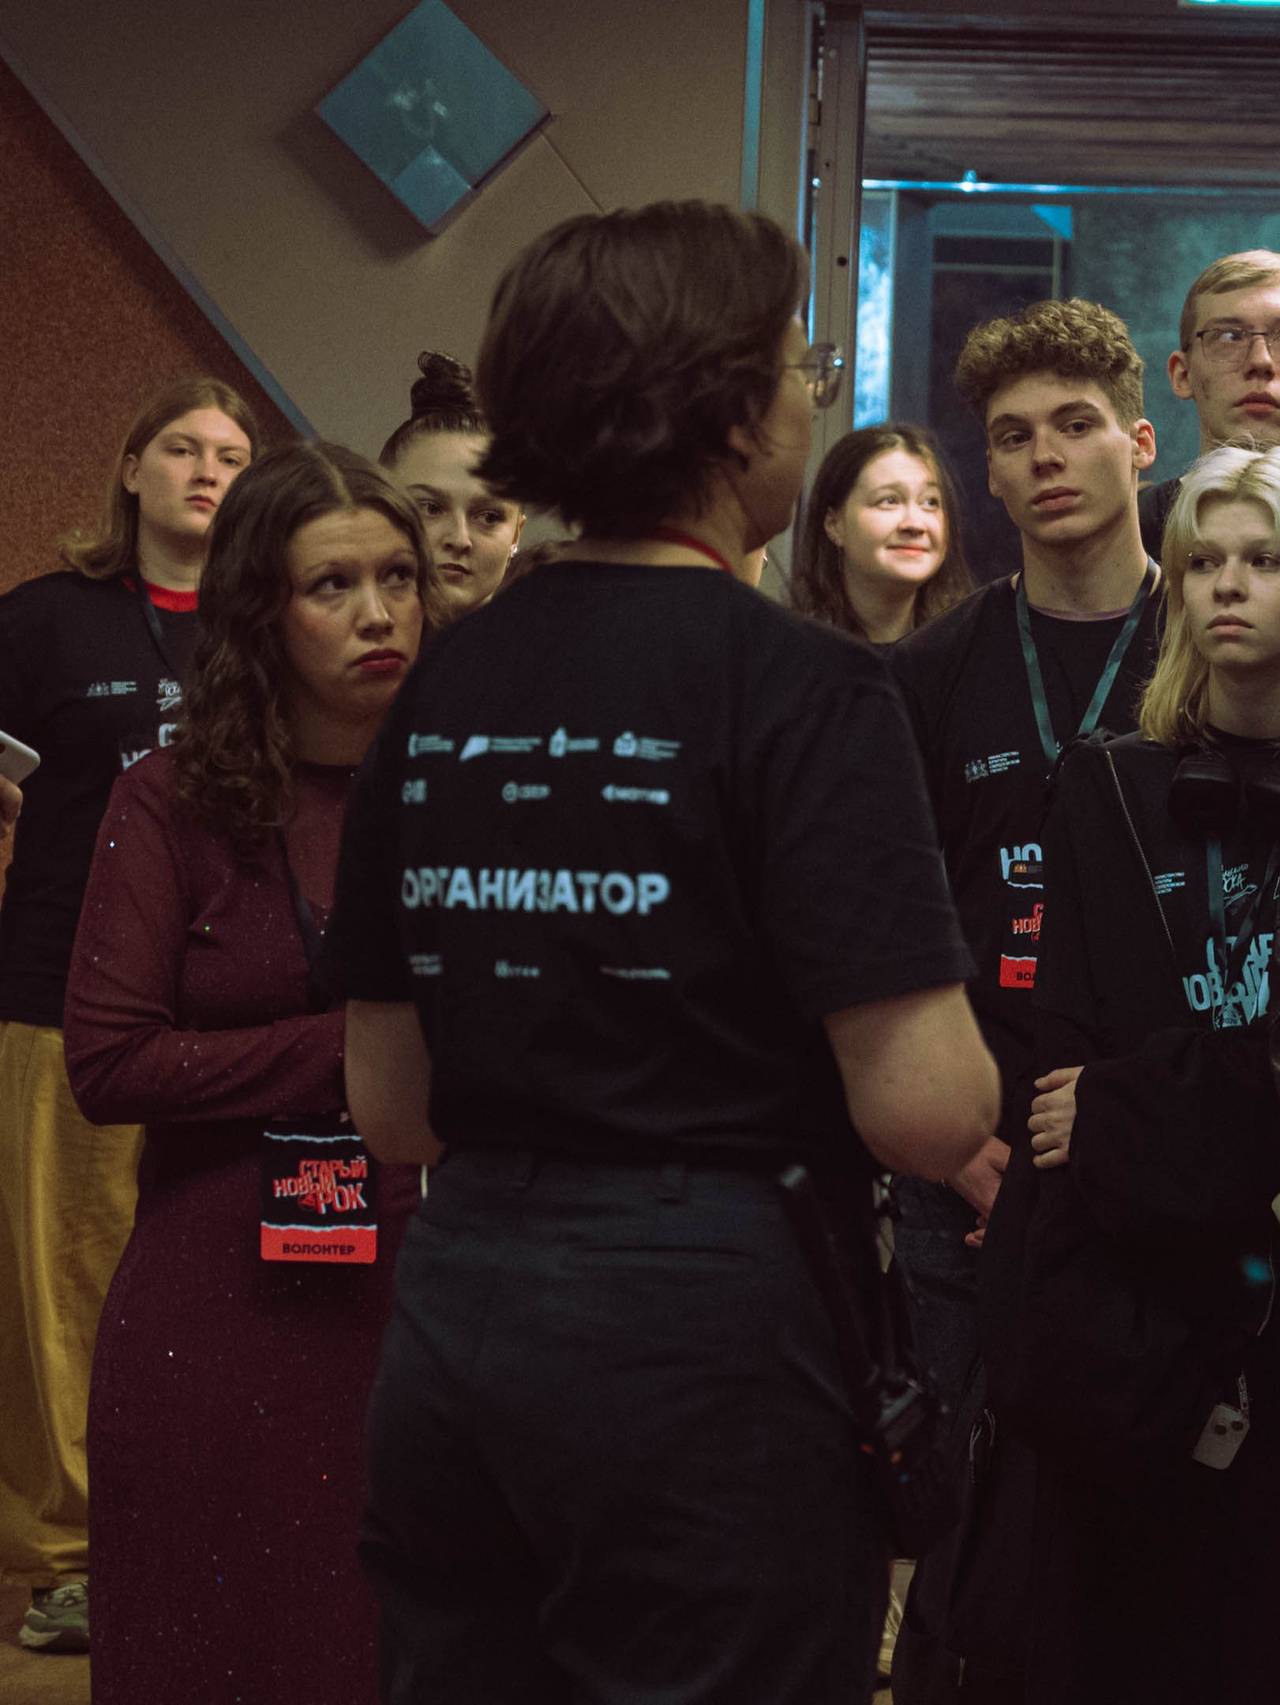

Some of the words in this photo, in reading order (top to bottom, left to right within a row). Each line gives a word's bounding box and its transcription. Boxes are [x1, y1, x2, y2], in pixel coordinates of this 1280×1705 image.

[402, 867, 669, 914] ОРГАНИЗАТОР
[299, 1155, 367, 1178] СТАРЫЙ
[273, 1173, 336, 1198] НОВЫЙ
[317, 1183, 367, 1214] РОК
[282, 1244, 355, 1255] ВОЛОНТЕР
